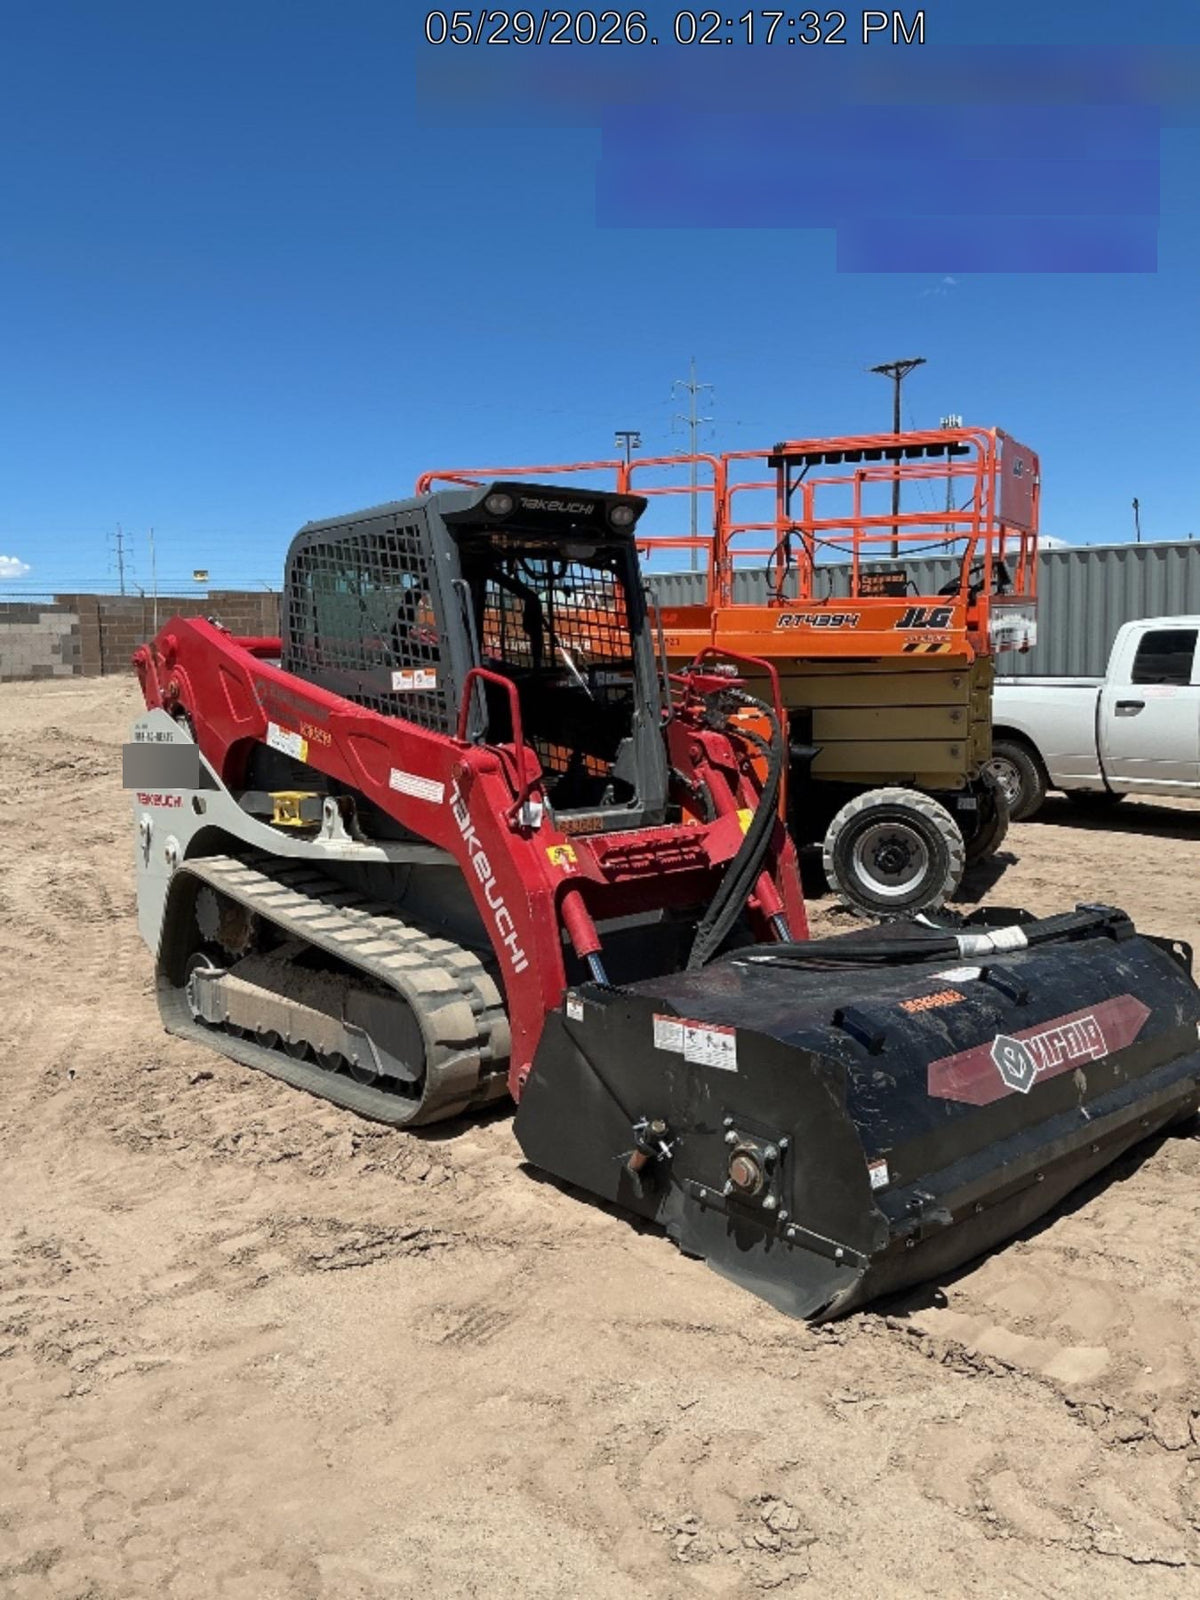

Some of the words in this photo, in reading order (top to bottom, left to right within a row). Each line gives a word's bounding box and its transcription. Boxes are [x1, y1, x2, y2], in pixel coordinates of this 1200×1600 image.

[776, 612, 861, 628] RT4394
[894, 606, 955, 630] JLG
[450, 778, 529, 974] TAKEUCHI
